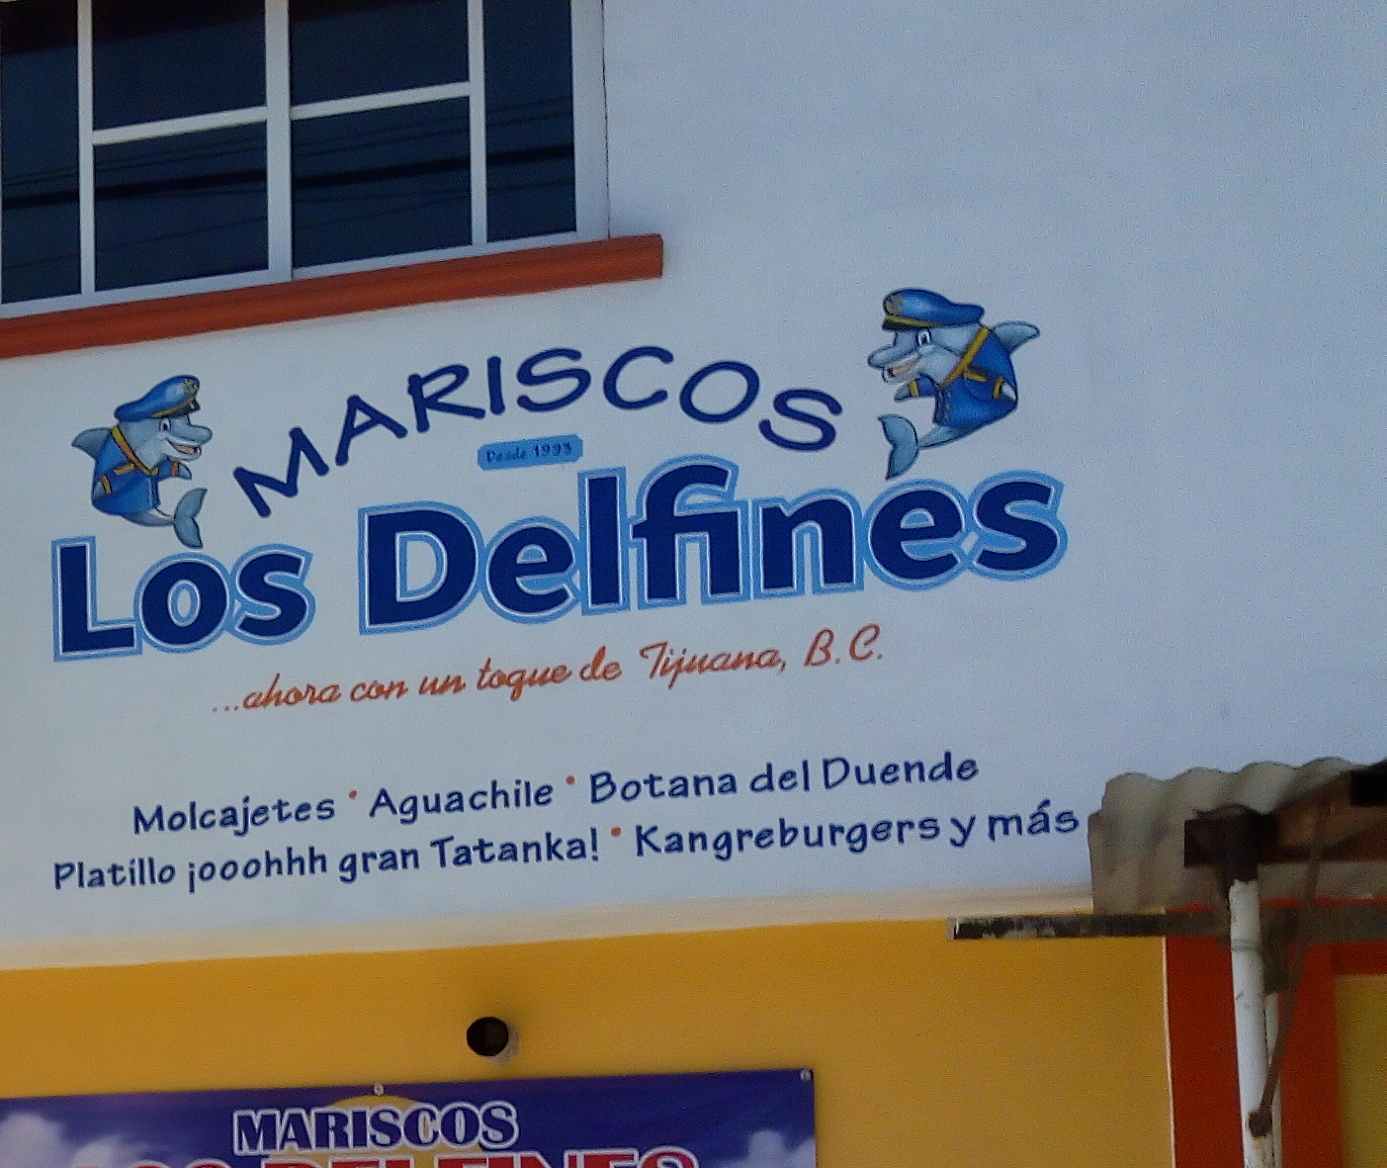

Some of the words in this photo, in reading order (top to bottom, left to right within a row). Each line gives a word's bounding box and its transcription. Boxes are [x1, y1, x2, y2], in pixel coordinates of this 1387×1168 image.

[234, 345, 842, 519] MARISCOS
[52, 535, 317, 661] Los
[360, 454, 1067, 636] Delfines
[350, 679, 408, 702] con
[419, 673, 465, 698] un
[476, 657, 571, 701] toque
[579, 645, 622, 683] de
[638, 642, 786, 689] Tijuana,
[133, 796, 335, 836] Molcajetes
[369, 779, 553, 825] Aguachile
[589, 771, 738, 803] Botana
[749, 760, 811, 793] del
[823, 751, 980, 790] Duende
[53, 857, 175, 889] Platillo
[338, 846, 420, 884] gran
[430, 827, 599, 870] Tatanka!
[636, 814, 940, 860] Kangreburgers
[948, 813, 976, 847] y
[987, 800, 1079, 842] más
[232, 1103, 520, 1154] MARISCOS
